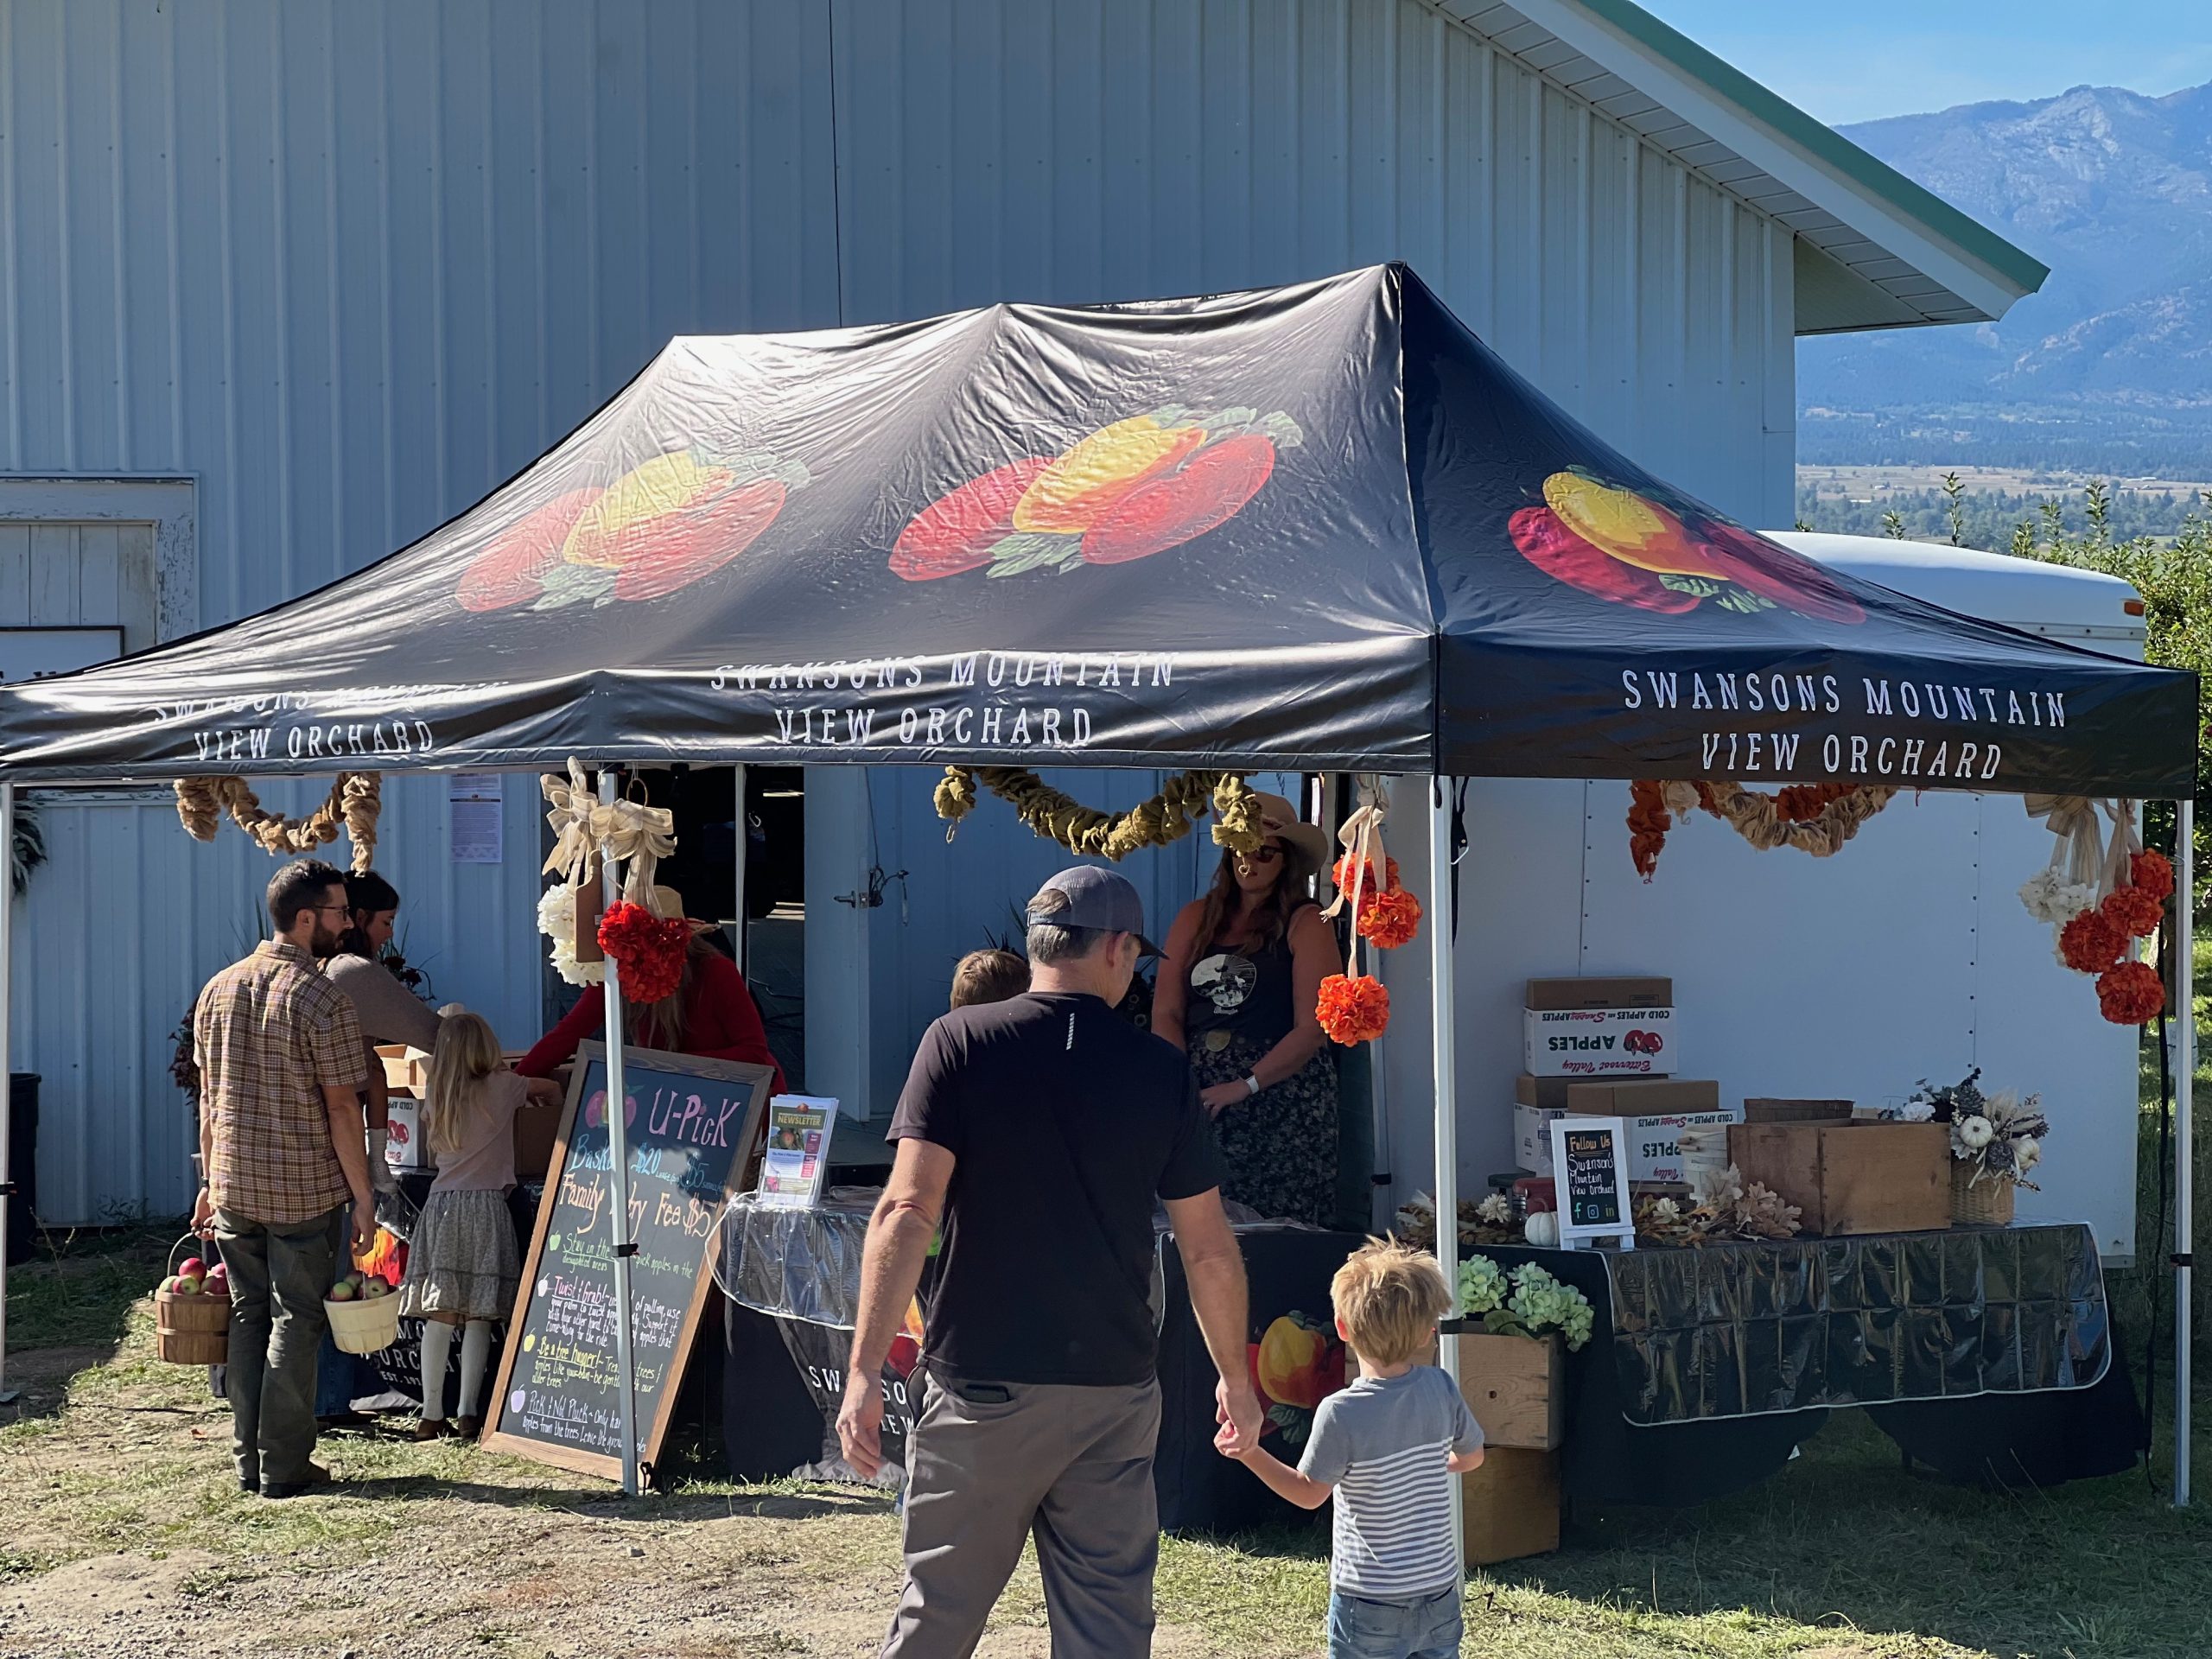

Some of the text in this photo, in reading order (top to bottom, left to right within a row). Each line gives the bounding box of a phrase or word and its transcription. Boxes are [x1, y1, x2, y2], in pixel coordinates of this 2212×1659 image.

[710, 651, 1179, 690] SWANSONS MOUNTAIN
[1622, 670, 2066, 728] SWANSONS MOUNTAIN
[774, 706, 1092, 745] VIEW ORCHARD
[194, 720, 433, 761] VIEW ORCHARD
[1700, 733, 2002, 779] VIEW ORCHARD
[1542, 1013, 1572, 1021] APPLES
[1617, 1011, 1647, 1020] APPLES
[1649, 1010, 1670, 1019] COLD
[1548, 1036, 1617, 1052] APPLES
[1561, 1059, 1595, 1073] Valley
[399, 1101, 413, 1110] COLD
[778, 1115, 821, 1126] NEWSLETTER
[1638, 1118, 1660, 1127] APPLES
[1694, 1115, 1716, 1124] APPLES
[1718, 1114, 1733, 1122] COLD
[1569, 1135, 1611, 1152] Follow Us
[1643, 1141, 1681, 1158] PPLES
[1568, 1153, 1614, 1172] Swanson's
[1569, 1173, 1602, 1185] Mountain
[1571, 1180, 1615, 1196] View Orchard
[559, 1173, 605, 1234] Family
[654, 1192, 681, 1227] Fee
[683, 1192, 718, 1237] $5
[563, 1232, 585, 1255] Stay
[587, 1243, 594, 1254] in
[597, 1237, 610, 1258] the
[651, 1255, 671, 1275] apples
[682, 1262, 693, 1279] the
[635, 1295, 645, 1311] of
[667, 1308, 681, 1320] use
[537, 1336, 550, 1356] Be
[606, 1356, 620, 1373] Trea
[636, 1362, 655, 1379] trees
[380, 1370, 423, 1386] EST. 191
